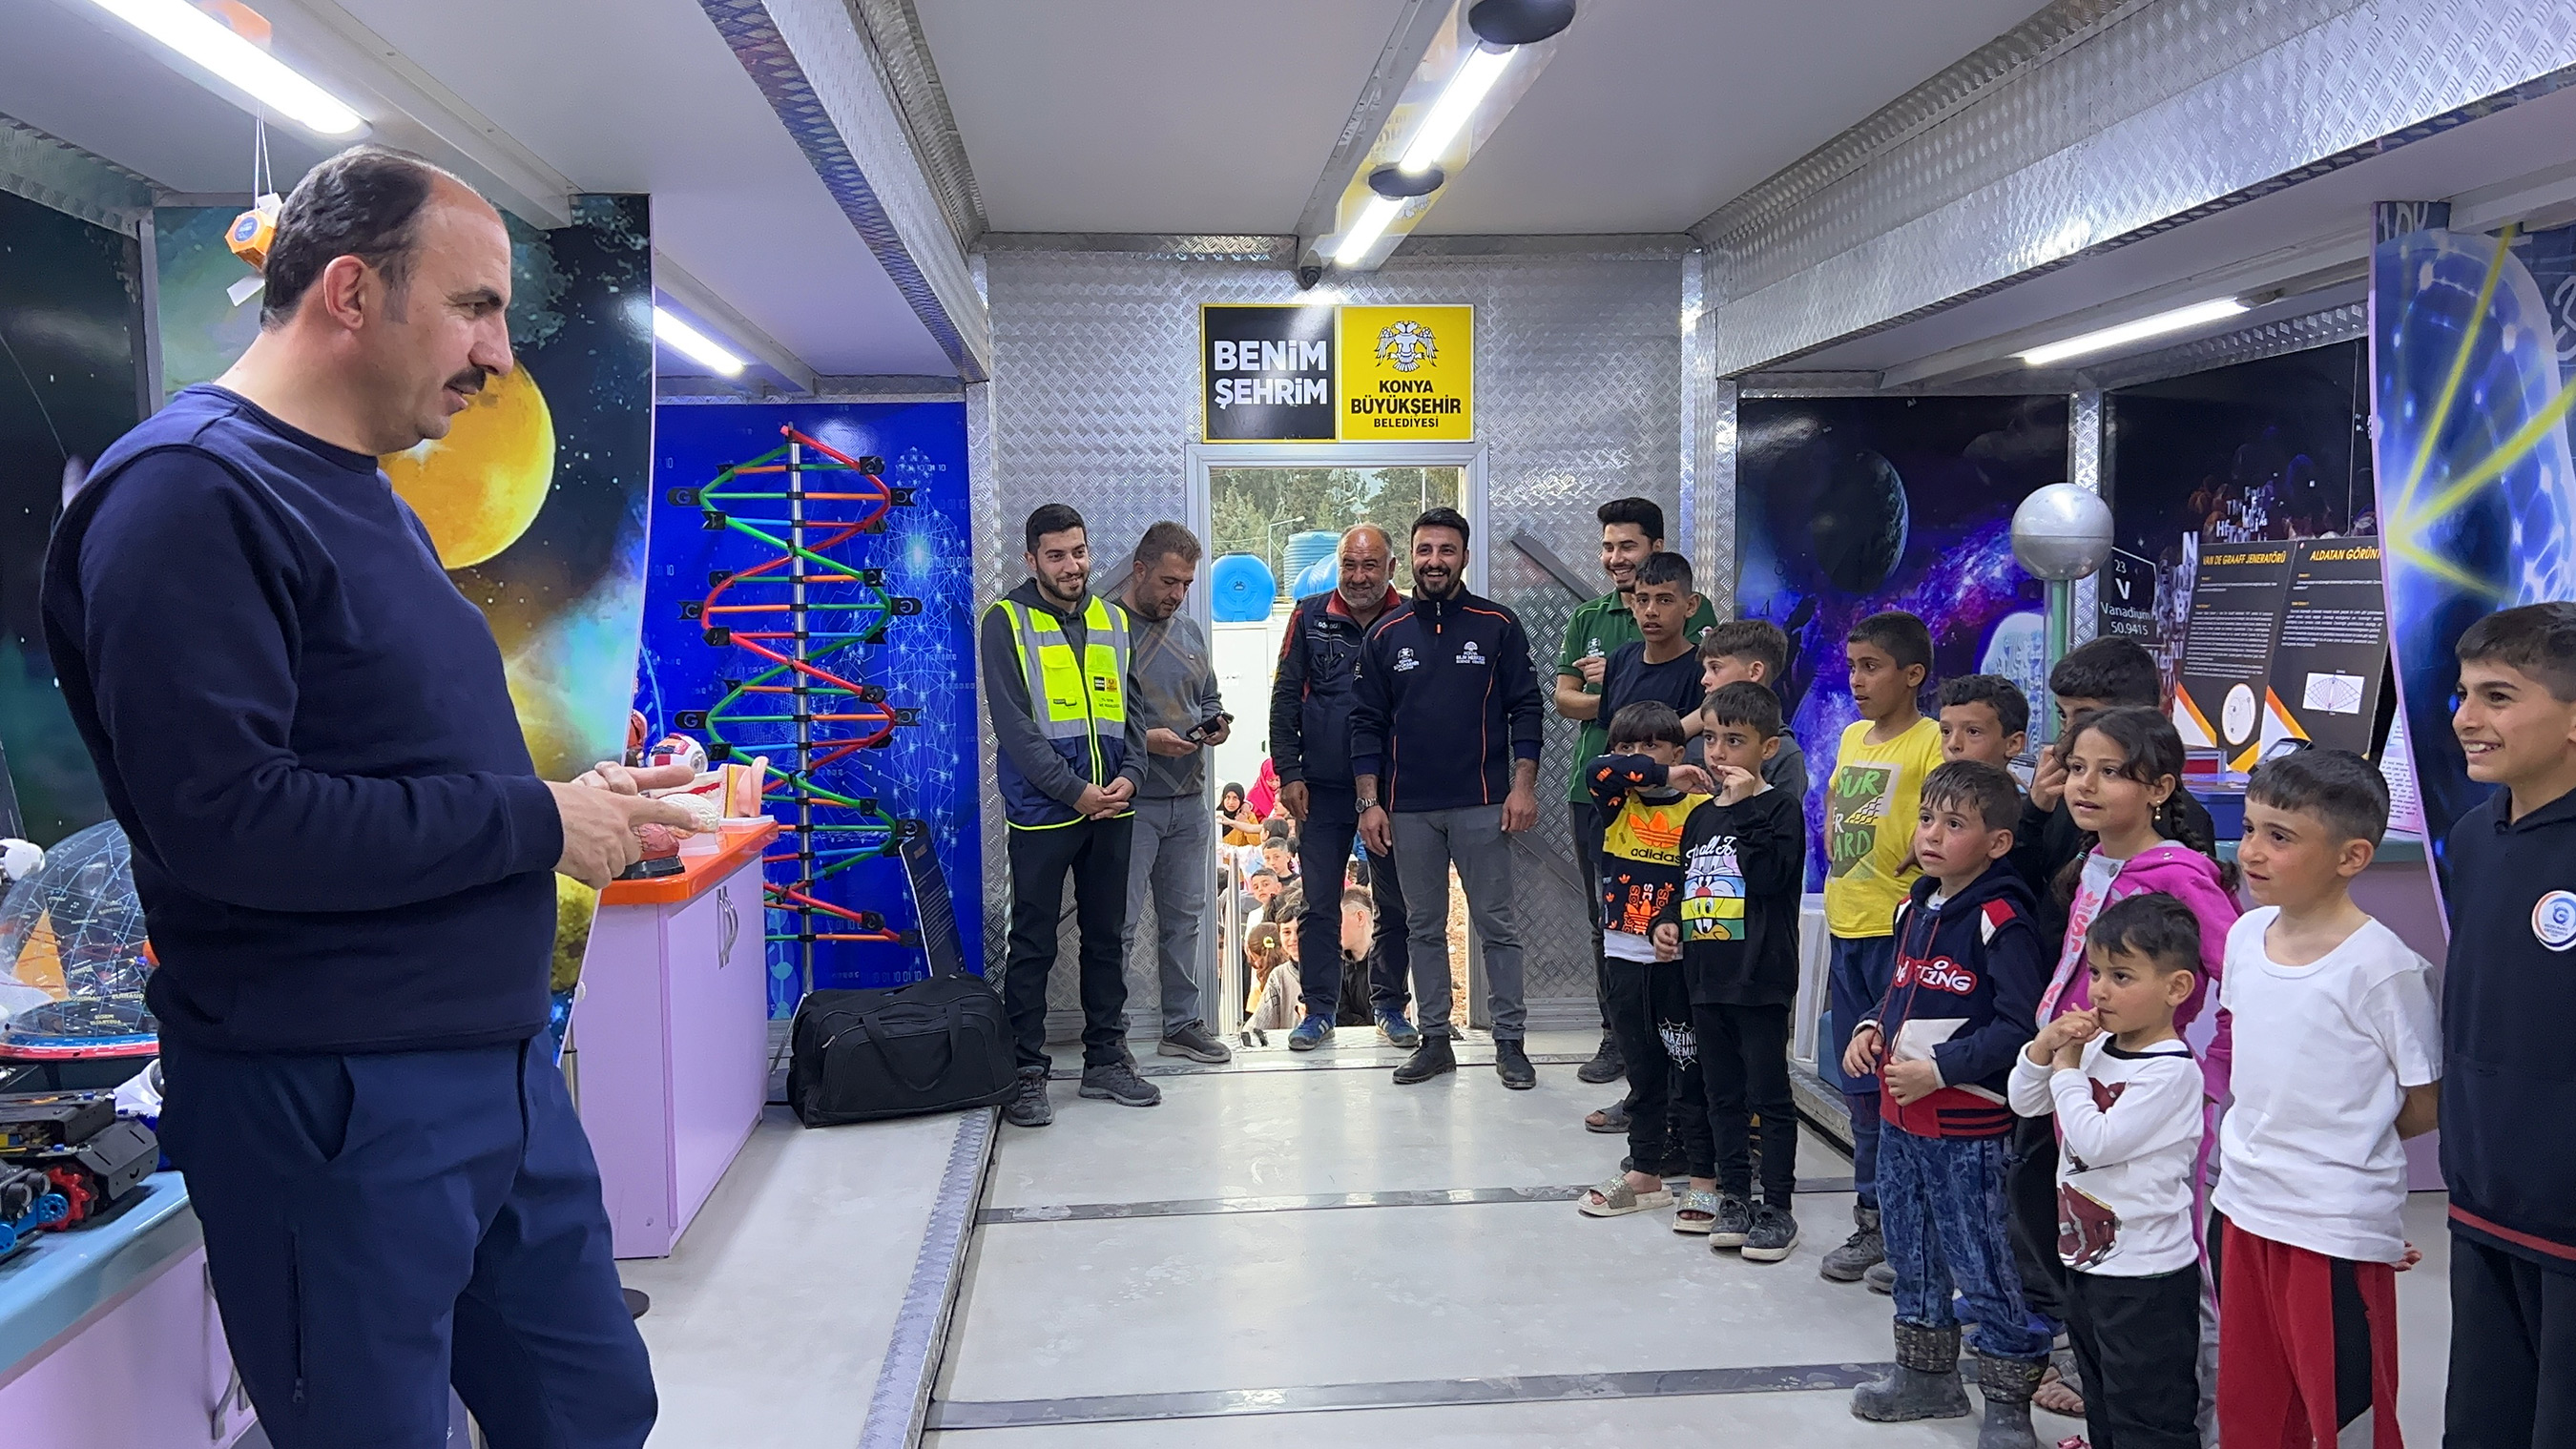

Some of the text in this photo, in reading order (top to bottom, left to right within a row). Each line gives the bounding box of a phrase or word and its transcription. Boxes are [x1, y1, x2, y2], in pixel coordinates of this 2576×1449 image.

[1214, 340, 1327, 371] BENİM
[1214, 378, 1328, 409] ŞEHRİM
[1380, 380, 1433, 393] KONYA
[1351, 394, 1462, 417] BÜYÜKŞEHİR
[1374, 416, 1439, 427] BELEDİYESİ
[675, 490, 691, 505] G
[2203, 550, 2287, 566] VAN DE GRAAFF JENERATÖRÜ
[2310, 549, 2345, 562] ALDATAN
[2114, 559, 2127, 573] 23
[2115, 577, 2130, 600] V
[2101, 602, 2150, 620] Vanadium
[2111, 621, 2149, 635] 50.9415
[683, 714, 698, 727] G
[1631, 848, 1681, 865] adidas
